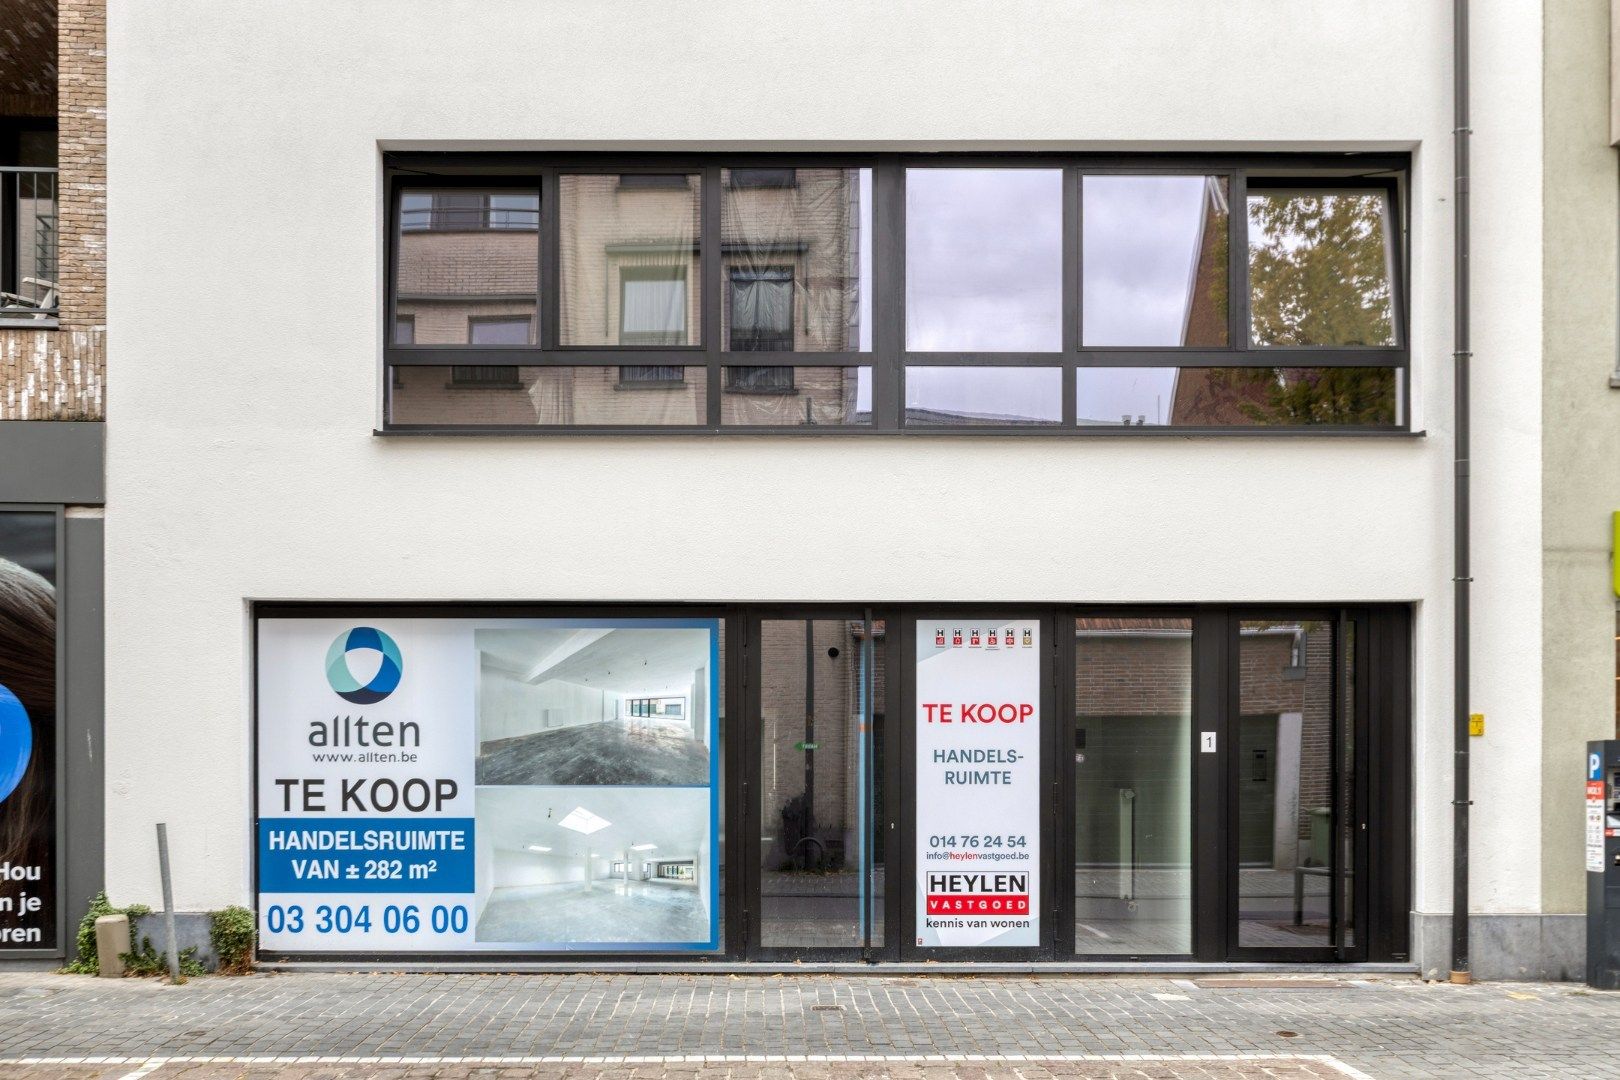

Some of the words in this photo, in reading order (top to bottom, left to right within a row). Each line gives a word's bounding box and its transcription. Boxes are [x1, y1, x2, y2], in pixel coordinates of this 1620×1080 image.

[922, 703, 953, 723] TE
[961, 703, 1034, 724] KOOP
[308, 715, 420, 748] allten
[1205, 736, 1212, 748] 1
[312, 751, 418, 763] www.allten.be
[933, 749, 1024, 764] HANDELS-
[1589, 753, 1600, 778] P
[945, 770, 1012, 785] RUIMTE
[275, 778, 326, 812] TE
[341, 777, 458, 813] KOOP
[268, 830, 466, 851] HANDELSRUIMTE
[929, 835, 957, 848] 014
[960, 835, 980, 848] 76
[983, 835, 1003, 848] 24
[1006, 835, 1027, 848] 54
[926, 851, 1030, 862] info@heylenvastgoed.be
[291, 860, 339, 879] VAN
[364, 860, 403, 880] 282
[930, 874, 1026, 893] HEYLEN
[17, 891, 42, 917] je
[930, 900, 1027, 910] VASTGOED
[267, 904, 304, 934] 03
[315, 904, 372, 934] 304
[383, 904, 420, 934] 06
[431, 904, 469, 934] 00
[926, 918, 964, 928] kennis
[967, 920, 987, 928] van
[990, 920, 1030, 928] wonen
